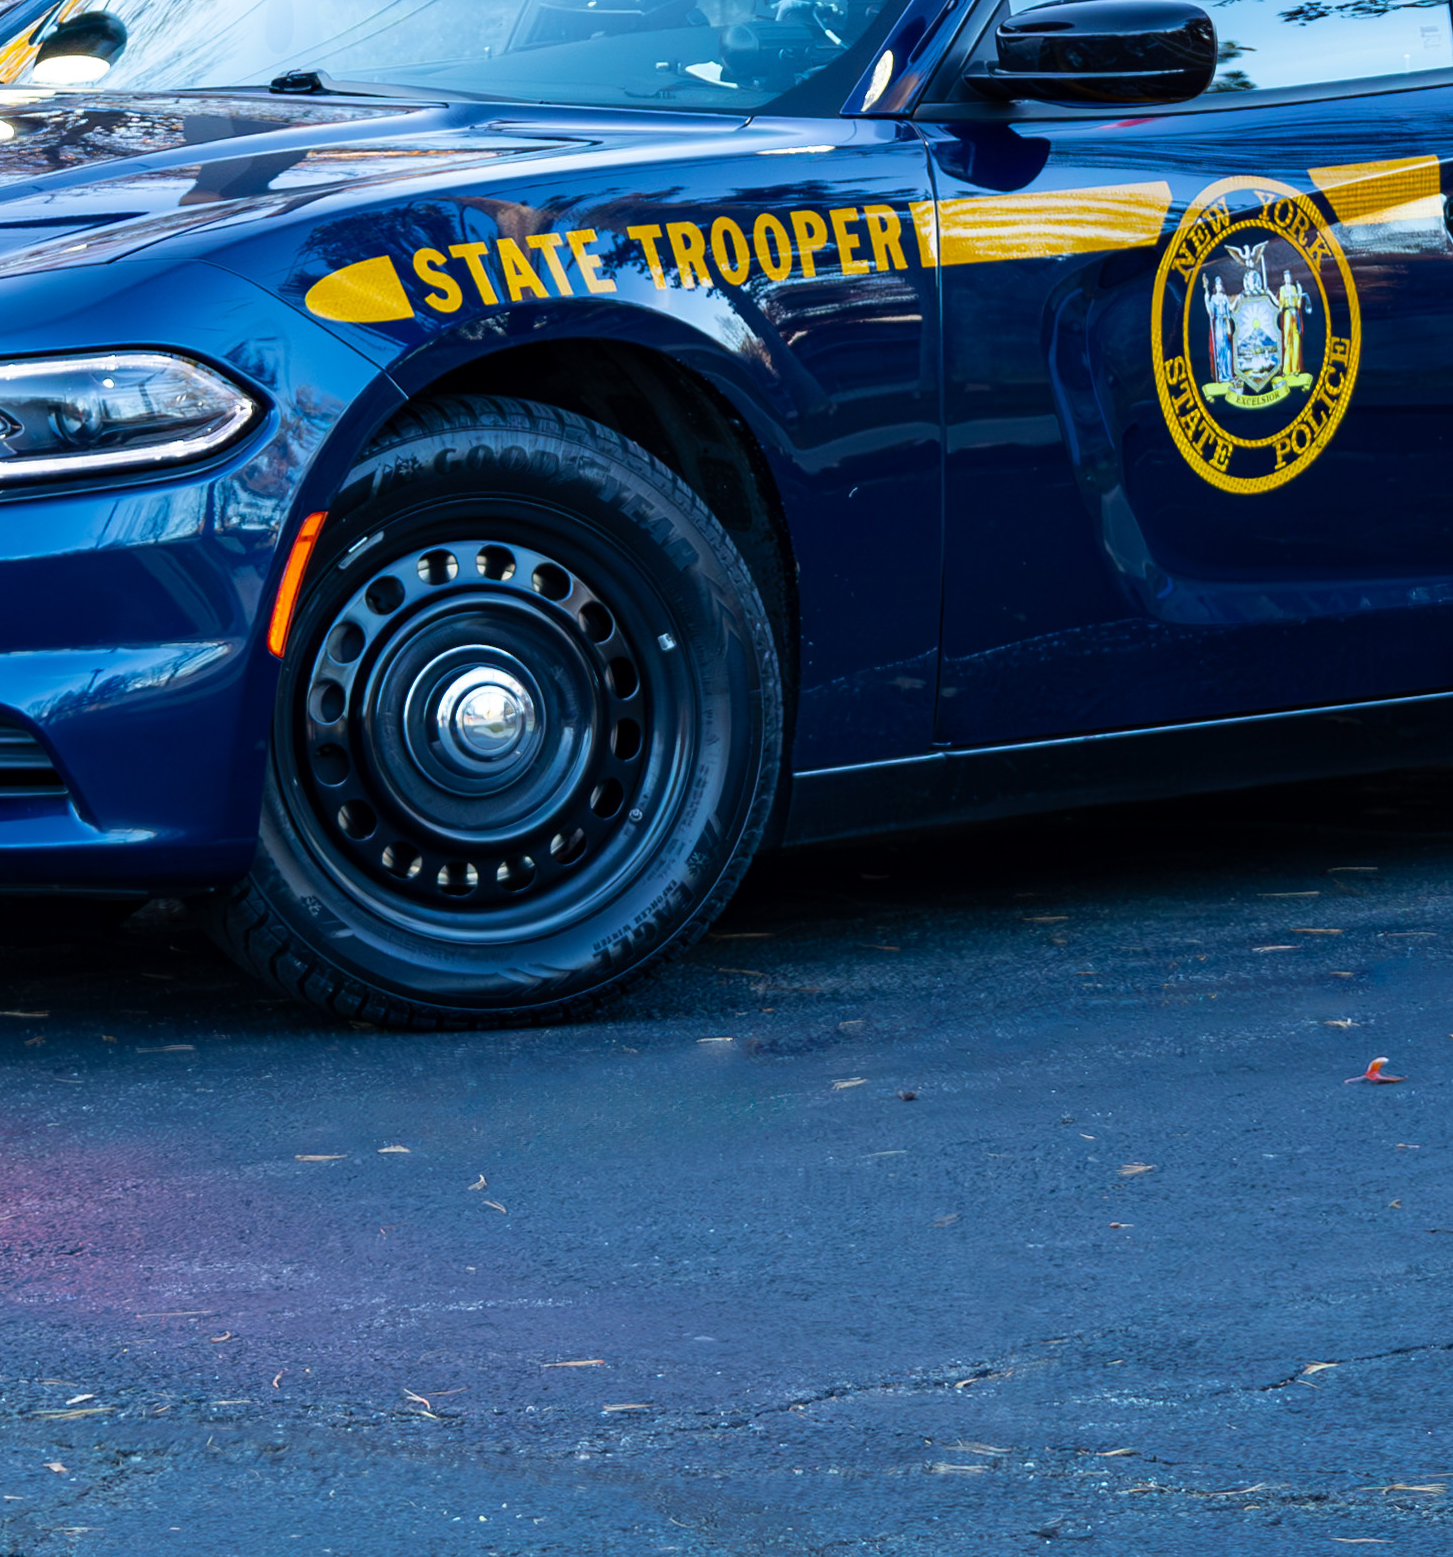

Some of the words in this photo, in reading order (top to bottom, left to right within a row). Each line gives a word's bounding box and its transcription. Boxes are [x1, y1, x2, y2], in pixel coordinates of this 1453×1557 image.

[412, 229, 617, 314] STATE
[627, 204, 908, 290] TROOPER
[1172, 196, 1231, 282] NEW
[1254, 190, 1332, 272] YORK
[1163, 355, 1234, 472] STATE
[1274, 336, 1351, 470] POLICE
[1236, 391, 1280, 406] EXCELSIOR
